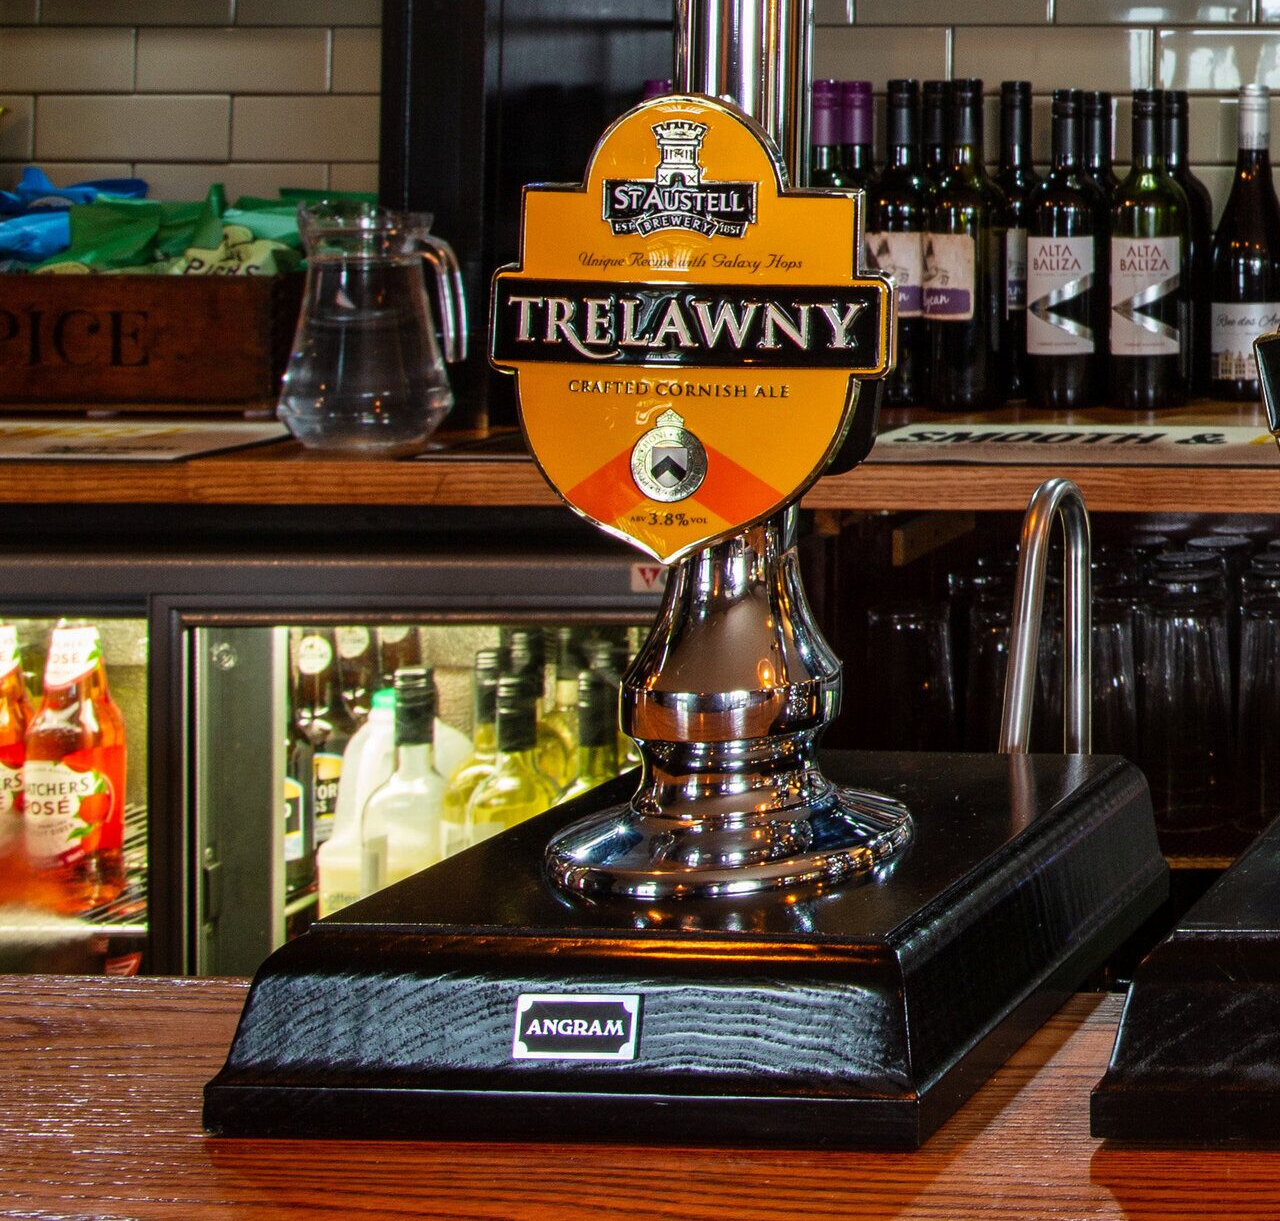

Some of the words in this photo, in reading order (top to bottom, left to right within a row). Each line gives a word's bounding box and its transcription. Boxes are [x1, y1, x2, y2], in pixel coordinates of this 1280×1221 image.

[643, 215, 711, 233] BREWERY
[1039, 245, 1073, 257] ALTA
[1127, 245, 1161, 257] ALTA
[577, 251, 625, 269] Unique
[629, 252, 674, 269] Recipe
[677, 253, 707, 267] with
[712, 254, 761, 273] Galaxy
[763, 253, 803, 272] Hops
[1033, 258, 1081, 271] BALIZA
[1120, 258, 1170, 271] BALIZA
[508, 293, 864, 360] TRELAWNY
[568, 379, 649, 396] CRAFTED
[655, 382, 748, 398] CORNISH
[755, 385, 790, 399] ALE
[893, 430, 1169, 445] SMOOTH
[1174, 432, 1229, 445] &
[648, 512, 689, 527] 3.8%
[690, 516, 708, 524] VOL
[525, 1019, 625, 1038] ANGRAM
